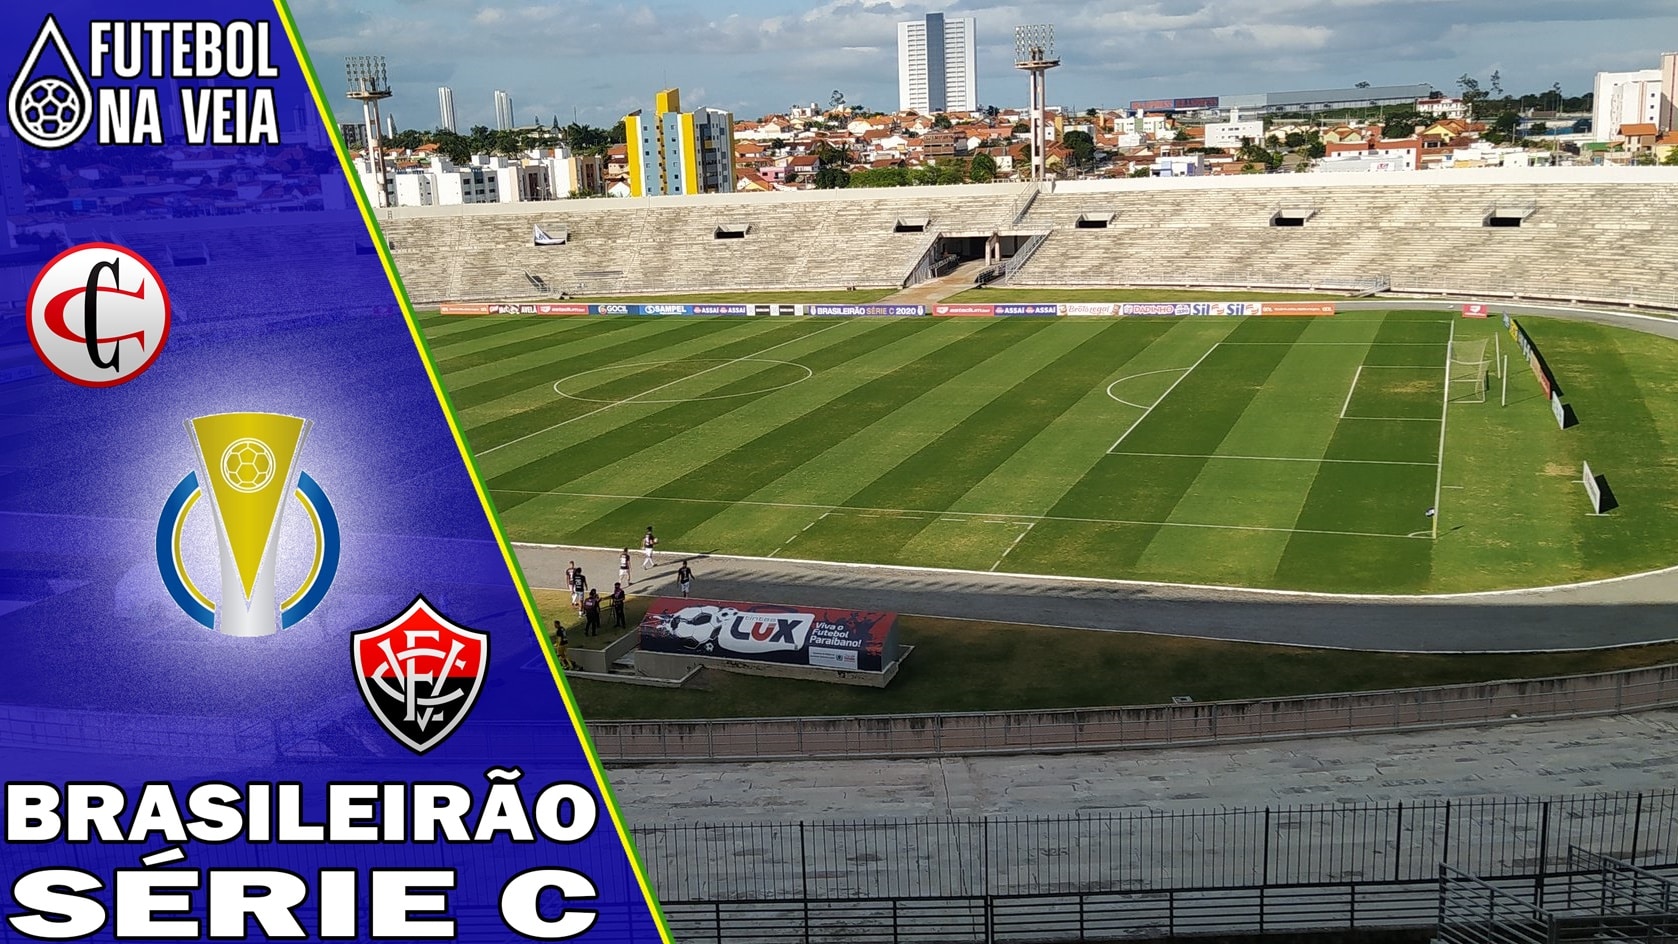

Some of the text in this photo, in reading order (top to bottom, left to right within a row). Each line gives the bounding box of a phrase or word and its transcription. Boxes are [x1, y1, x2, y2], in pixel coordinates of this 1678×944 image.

[655, 305, 687, 313] SAMPEL
[817, 306, 865, 315] BRASILEIRÃO
[866, 306, 887, 315] SÉRIE
[896, 307, 916, 315] 2020
[1134, 305, 1173, 313] DADINHO
[1193, 303, 1210, 315] Sil
[1227, 303, 1244, 315] Sil
[745, 615, 777, 623] tintas
[730, 615, 804, 644] LUX
[816, 622, 836, 631] Viva
[812, 628, 849, 639] Futebol
[809, 635, 863, 648] Paraibano!
